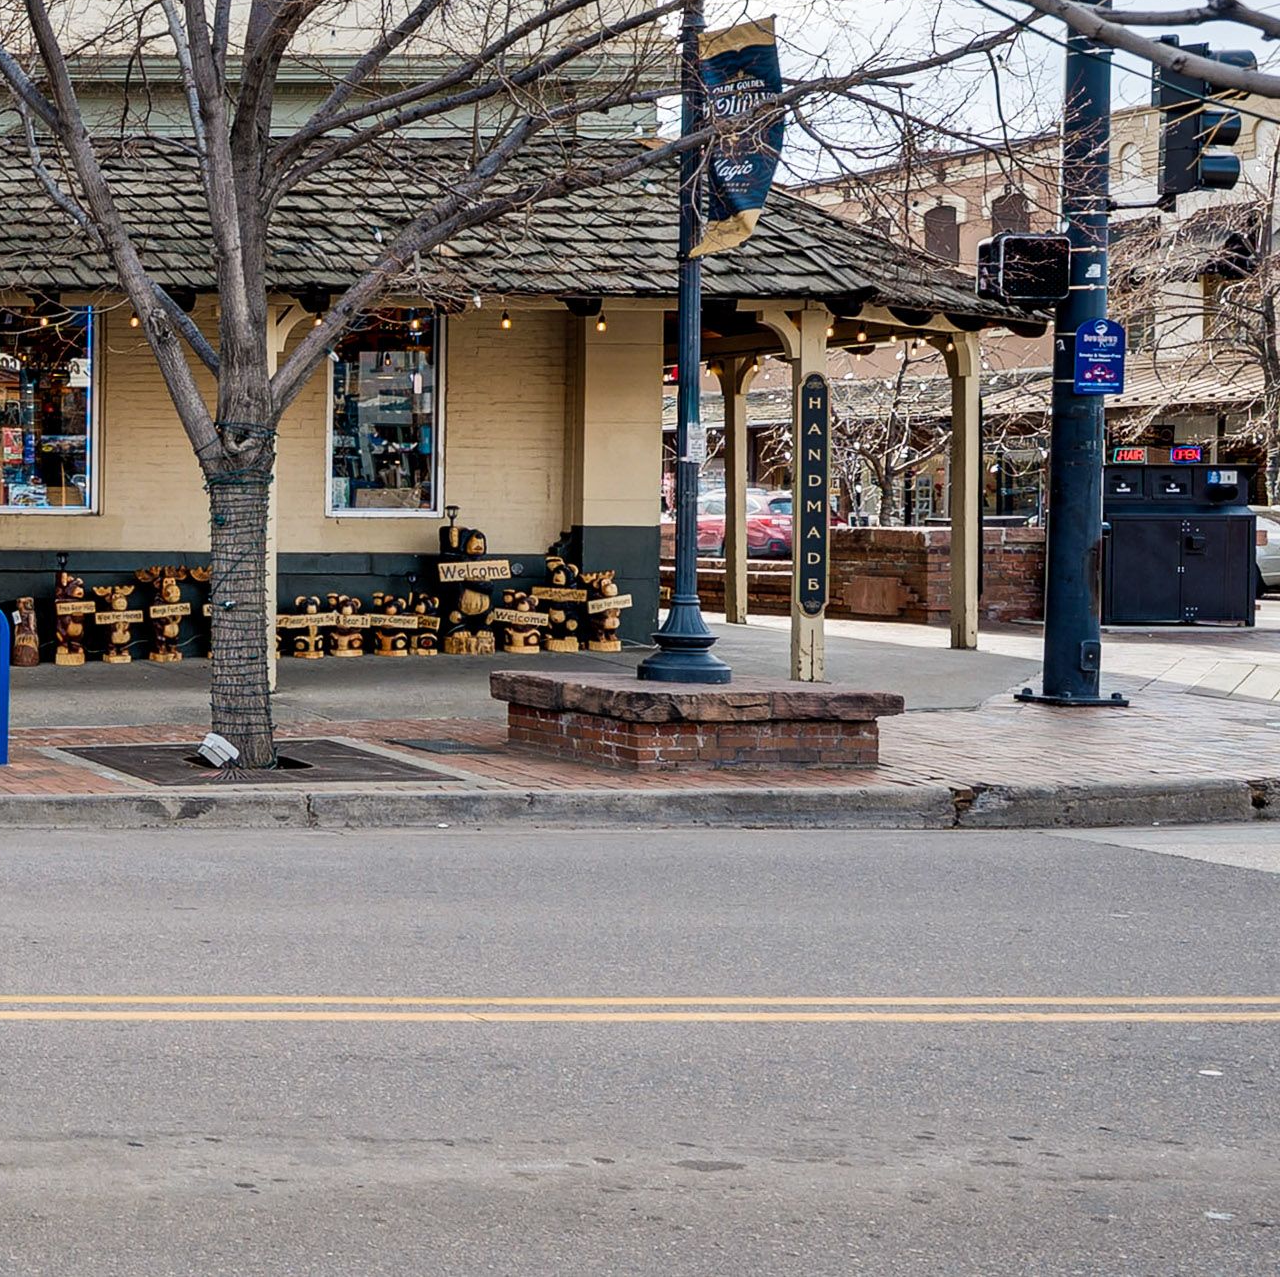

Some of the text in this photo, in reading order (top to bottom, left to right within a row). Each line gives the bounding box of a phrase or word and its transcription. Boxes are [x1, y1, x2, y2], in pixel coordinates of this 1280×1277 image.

[737, 79, 765, 91] GOLDEN
[1117, 449, 1145, 461] HAIR
[1173, 448, 1200, 460] OPEN
[440, 565, 509, 580] Welcome
[388, 616, 416, 626] Camper
[495, 610, 547, 624] Welcome
